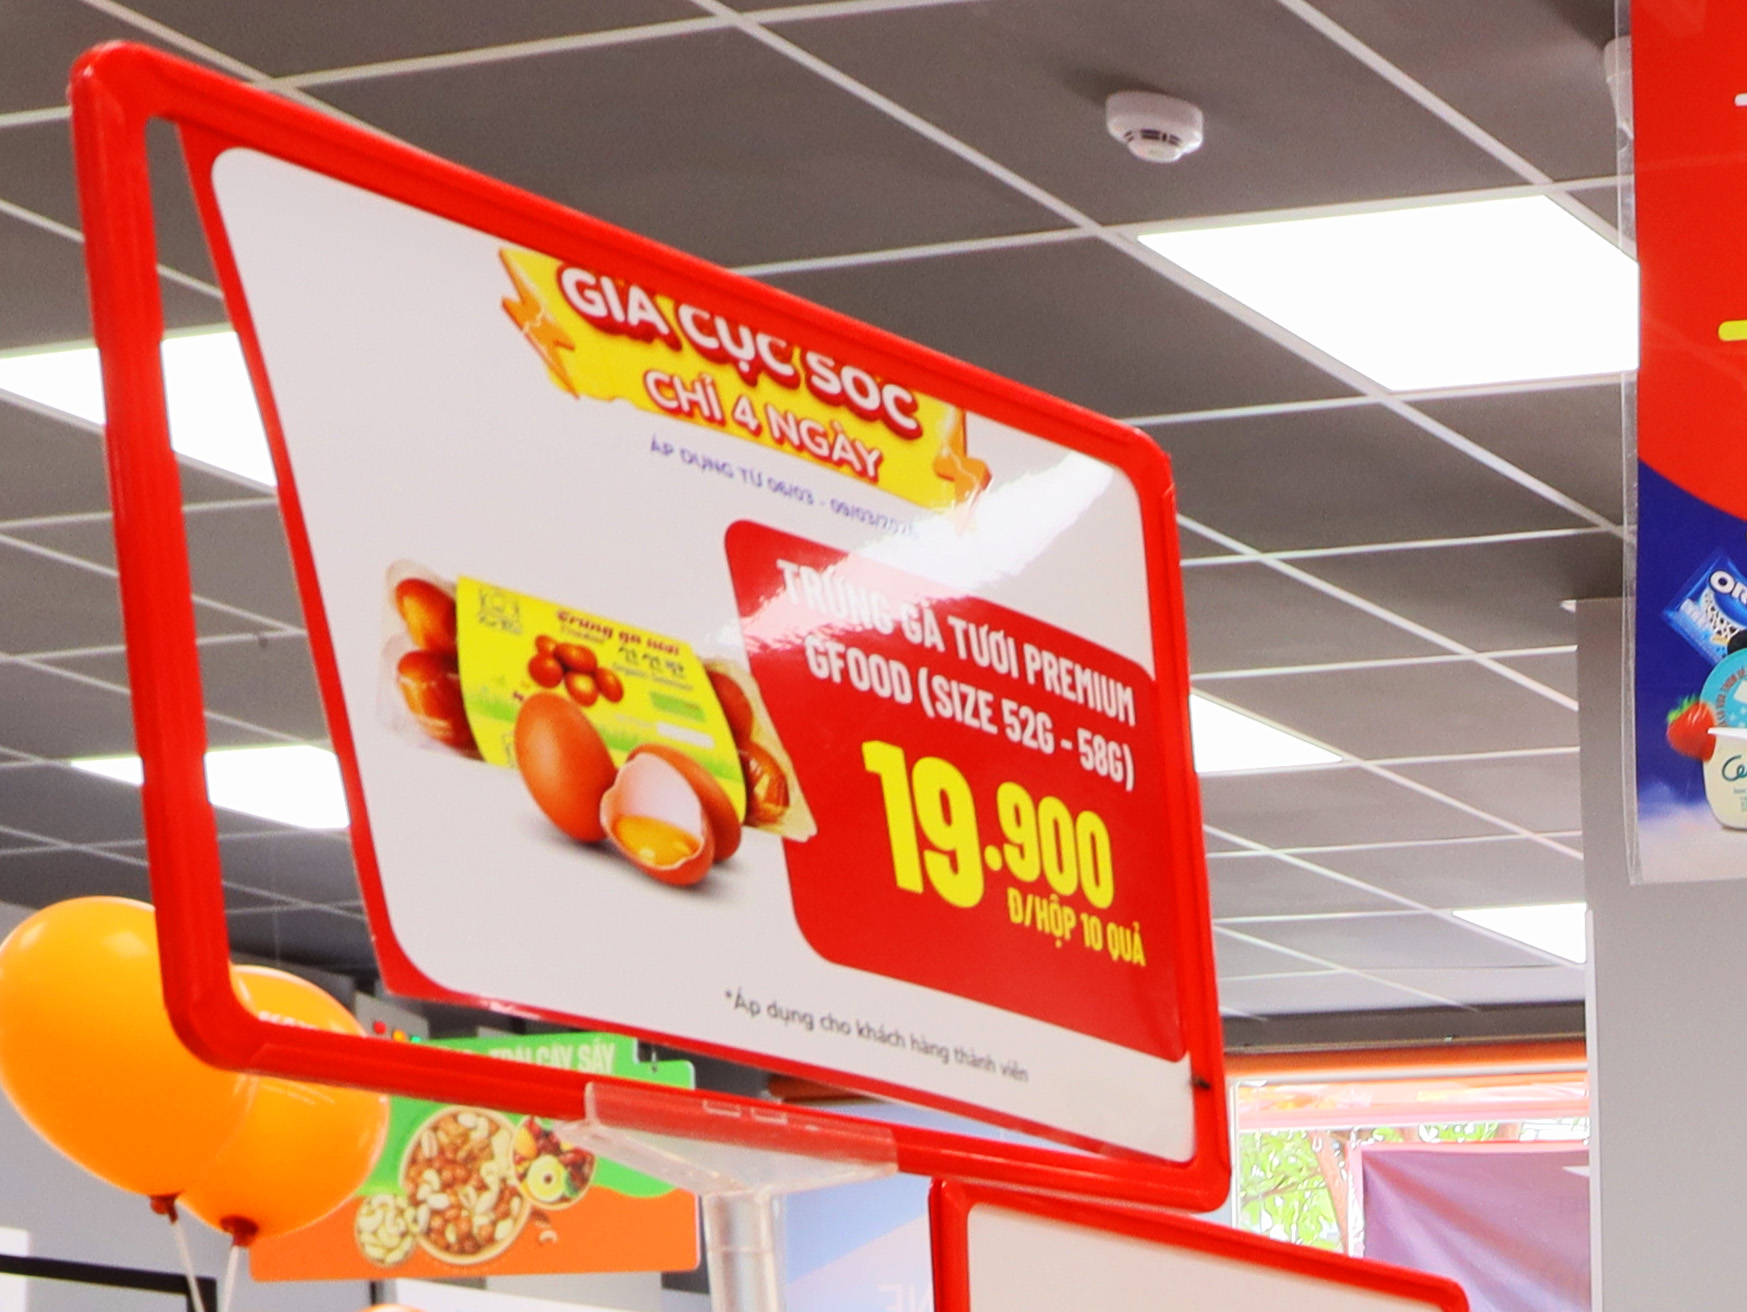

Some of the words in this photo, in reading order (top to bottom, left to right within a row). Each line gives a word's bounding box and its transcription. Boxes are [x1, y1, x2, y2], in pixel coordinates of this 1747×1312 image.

[645, 368, 723, 424] CHỈ
[731, 399, 764, 434] 4
[767, 410, 884, 480] NGÀY
[776, 558, 894, 635] TRỨNG
[900, 600, 946, 653] GÀ
[947, 614, 1019, 679] TƯƠI
[1024, 643, 1137, 728] PREMIUM
[804, 634, 913, 704] GFOOD
[918, 667, 999, 737] (SIZE
[1002, 699, 1055, 755] 52G
[1077, 729, 1135, 792] 58G)
[861, 739, 1115, 910] 19.900
[1006, 887, 1078, 948] Đ/HỘP
[1080, 912, 1104, 952] 10
[1106, 920, 1147, 968] QUẢ
[766, 998, 815, 1033] dụng
[819, 1012, 852, 1037] cho
[855, 1018, 907, 1051] khách
[909, 1033, 950, 1065] hàng
[952, 1045, 998, 1074] thành
[999, 1059, 1031, 1084] viên
